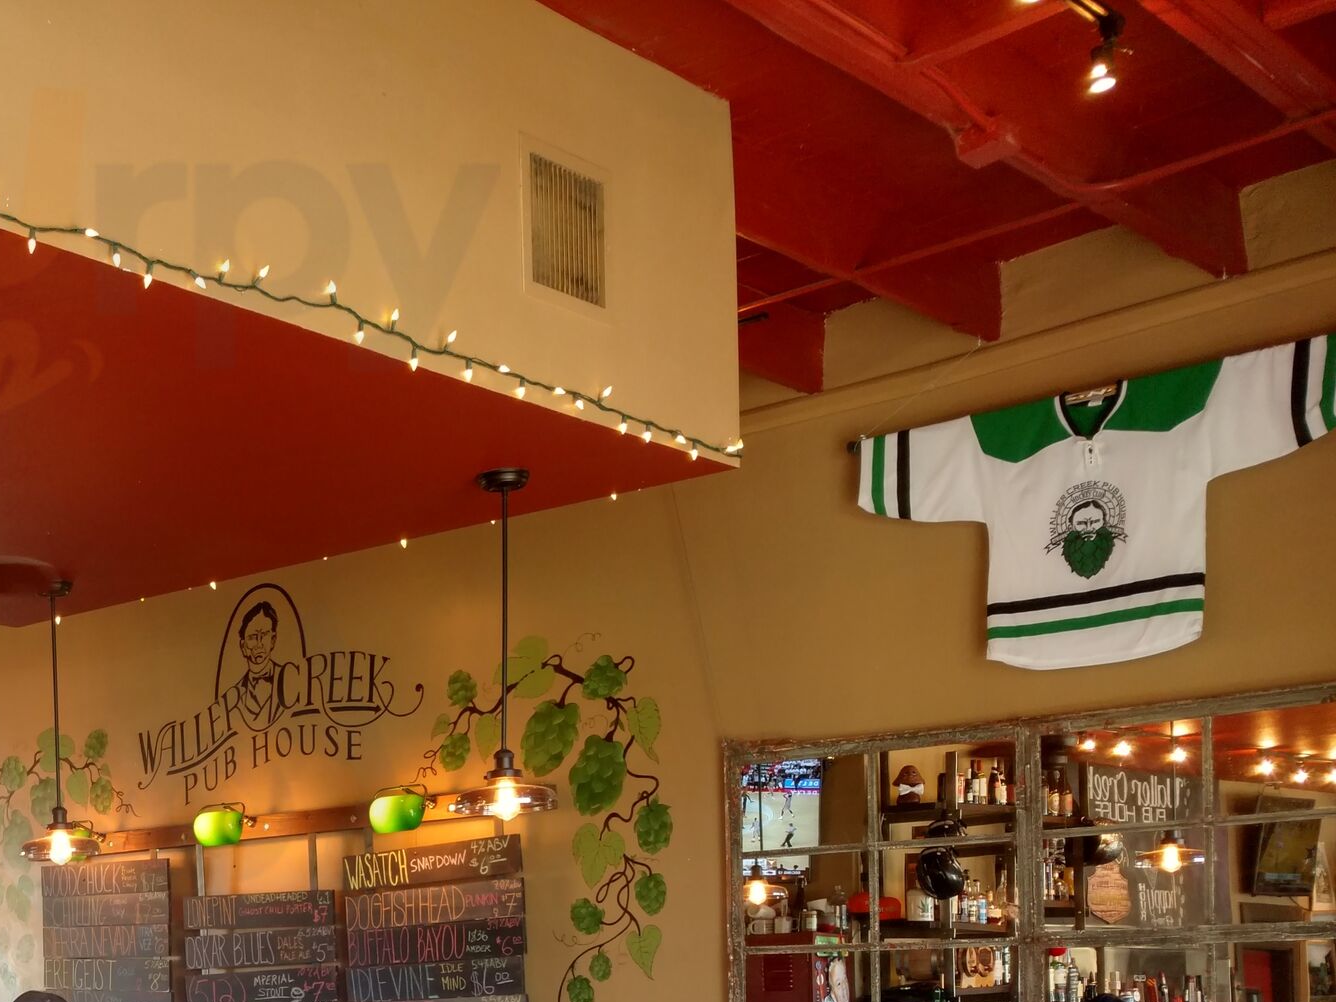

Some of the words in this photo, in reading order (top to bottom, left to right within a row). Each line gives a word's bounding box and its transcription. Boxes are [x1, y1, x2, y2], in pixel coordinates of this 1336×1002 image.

[1066, 480, 1101, 496] CREEK
[1102, 481, 1121, 496] PUB
[138, 686, 254, 789] WALLER
[276, 651, 395, 720] CREEK
[183, 745, 238, 806] PUB
[251, 724, 363, 769] HOUSE
[344, 848, 409, 891] WASATCH
[345, 889, 415, 932] DOGFISH
[418, 885, 465, 925] HEAD
[185, 934, 230, 969] OSKAR
[232, 930, 275, 966] BLUES
[276, 935, 304, 950] DALES
[348, 926, 410, 967] BUFFALO
[417, 923, 465, 962] BAYOU
[465, 943, 491, 953] AMBER
[441, 977, 467, 991] MIND
